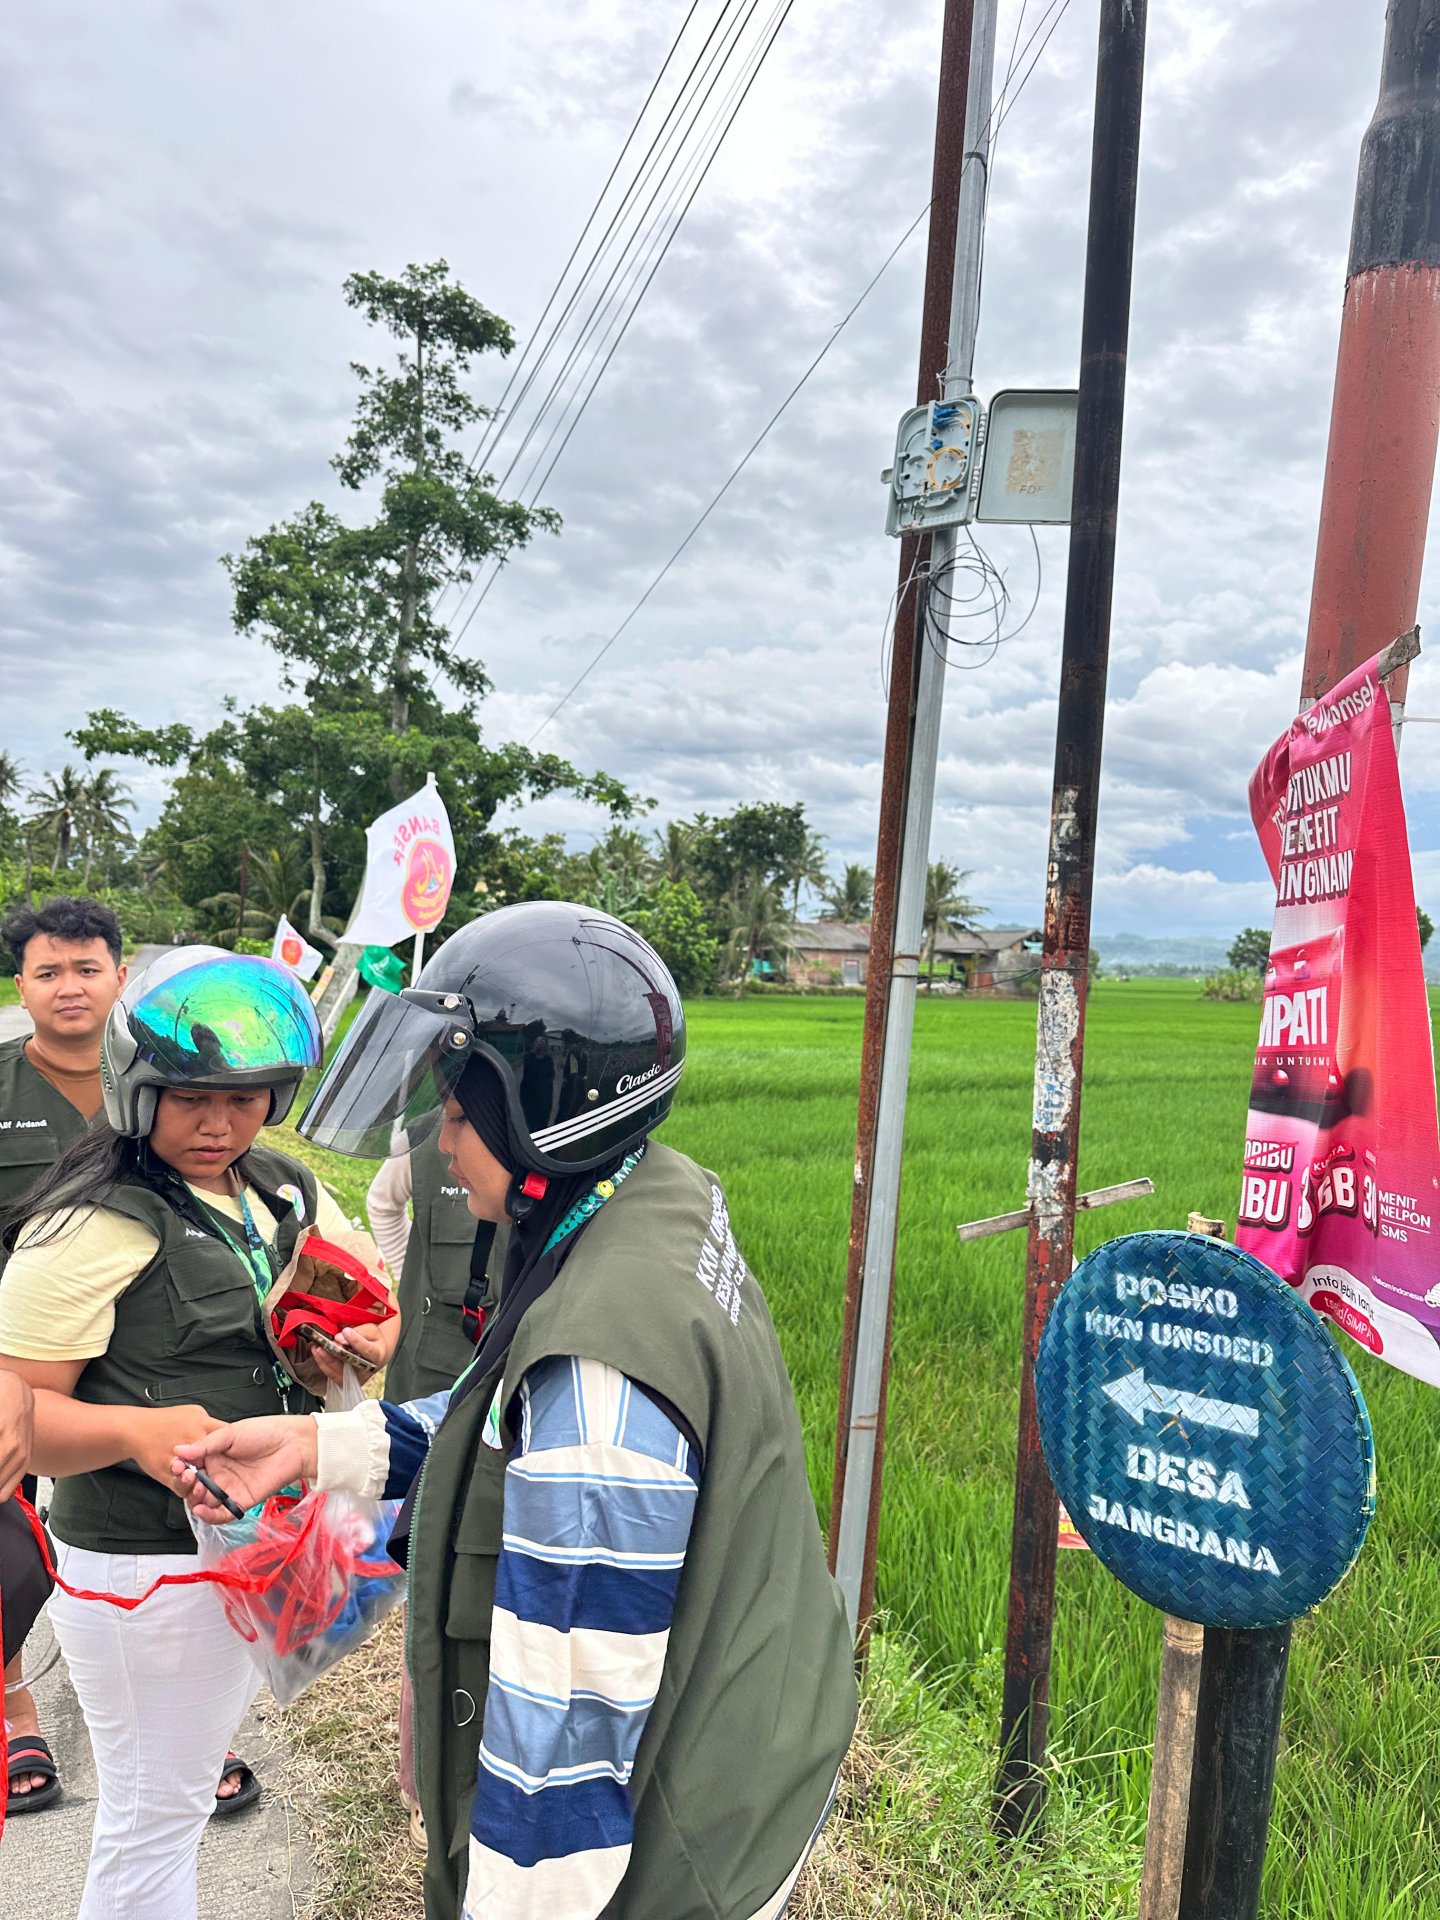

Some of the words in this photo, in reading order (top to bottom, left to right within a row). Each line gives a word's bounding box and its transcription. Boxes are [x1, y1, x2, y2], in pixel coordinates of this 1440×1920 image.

[1302, 674, 1375, 739] Telkomsel
[616, 1063, 662, 1095] Classic
[1378, 1189, 1418, 1211] MENIT
[1380, 1203, 1432, 1229] NELPON
[1381, 1224, 1409, 1243] SMS
[696, 1237, 719, 1292] KKN
[1312, 1275, 1339, 1290] Info
[1115, 1272, 1240, 1320] POSKO
[1085, 1311, 1145, 1343] KKN
[1151, 1321, 1275, 1369] UNSOED
[1126, 1444, 1252, 1511] DESA
[1088, 1494, 1282, 1577] JANGRANA
